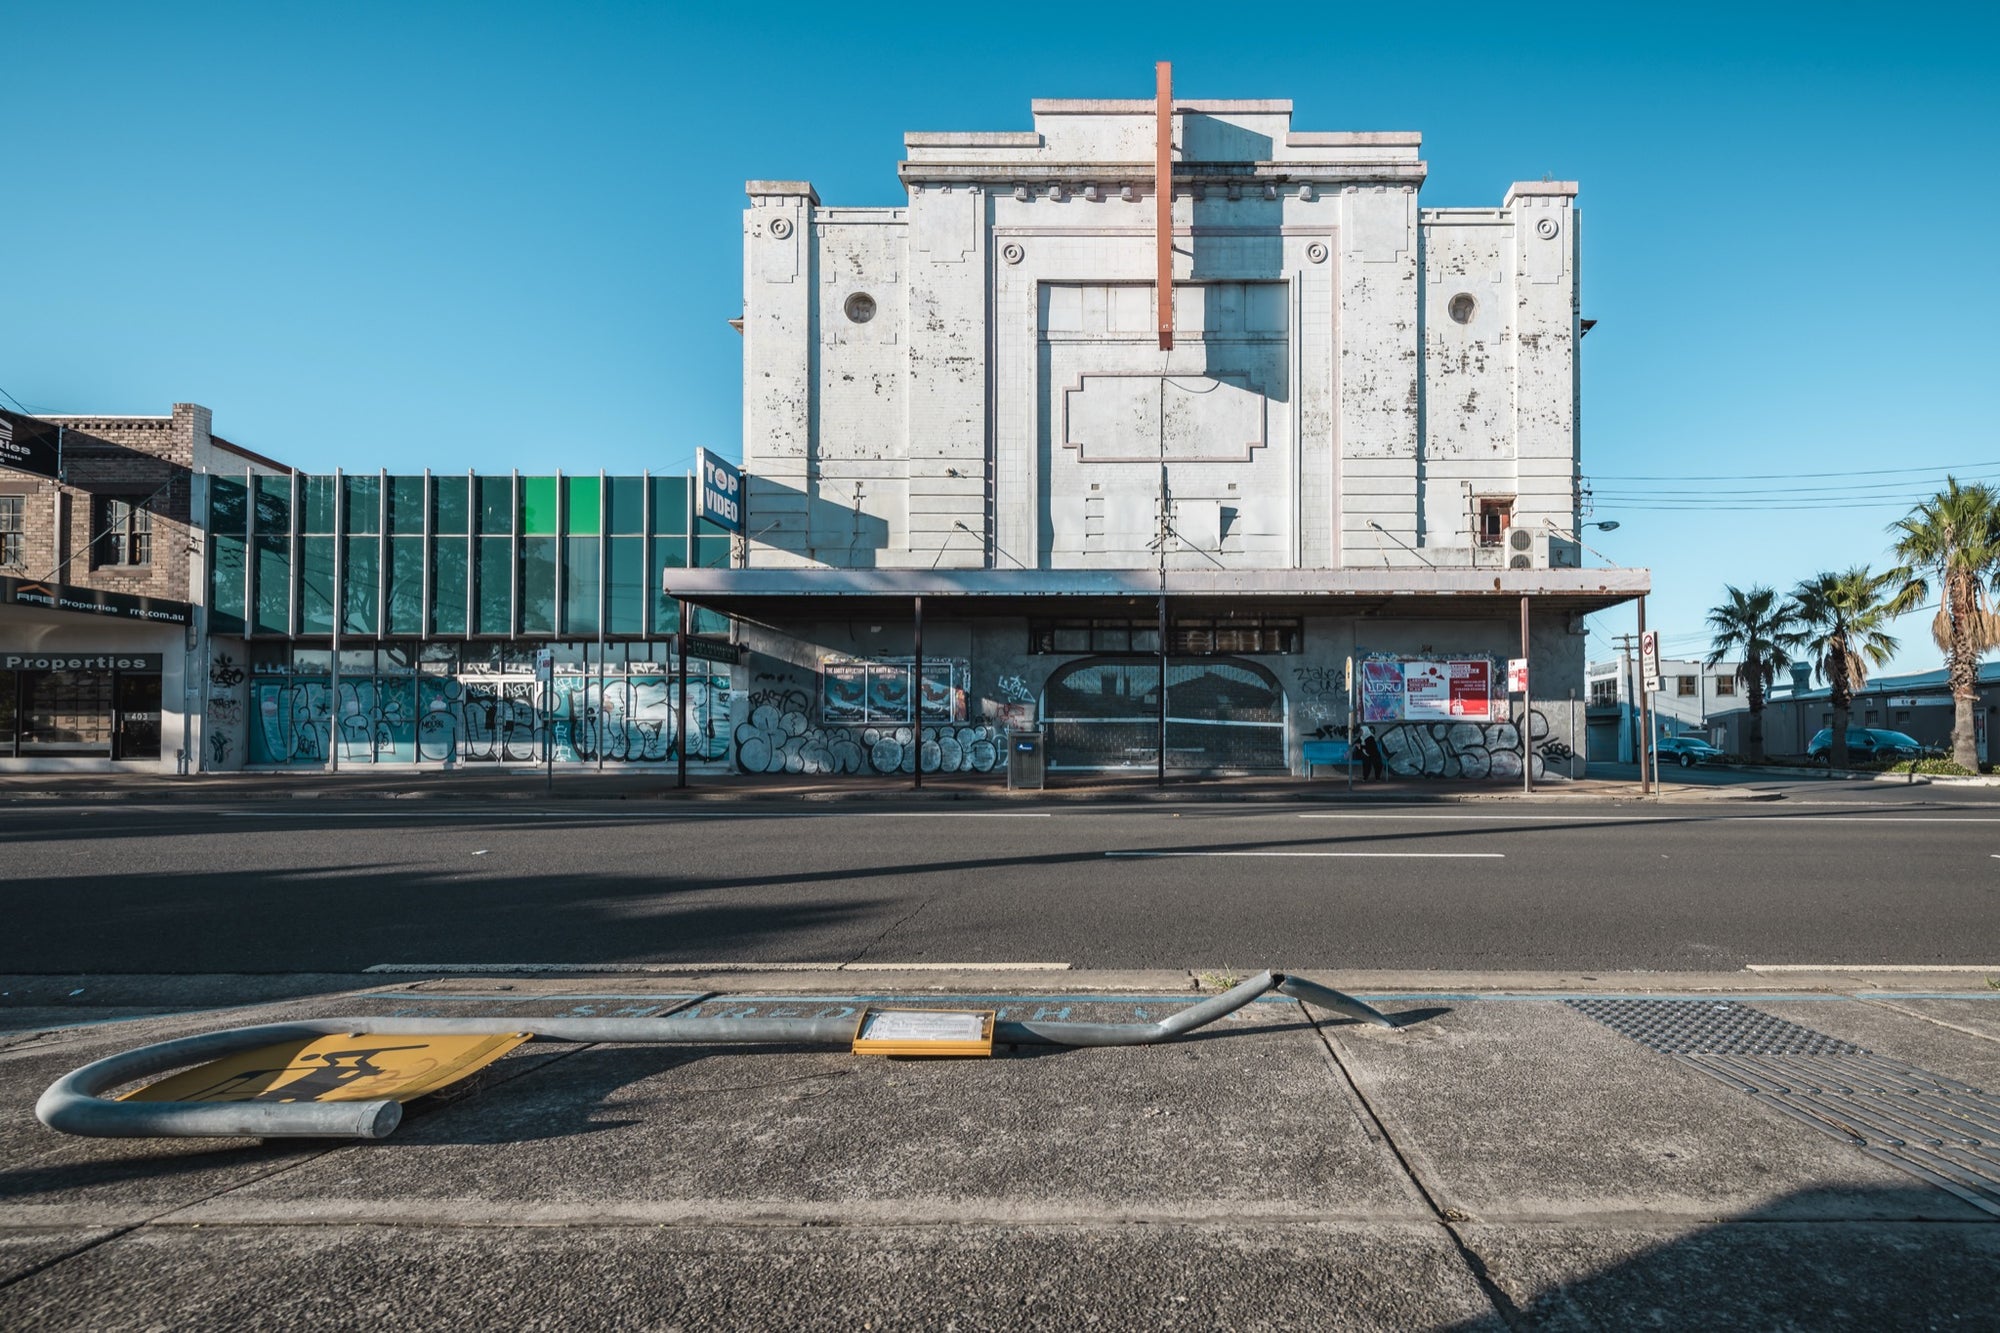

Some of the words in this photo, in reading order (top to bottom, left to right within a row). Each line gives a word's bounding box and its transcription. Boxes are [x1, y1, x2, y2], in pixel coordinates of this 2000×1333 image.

[705, 460, 738, 495] TOP
[705, 487, 738, 523] VIDEO
[59, 598, 118, 613] Properties
[130, 607, 185, 621] rre.com.au
[6, 655, 147, 671] Properties
[131, 712, 148, 720] 403
